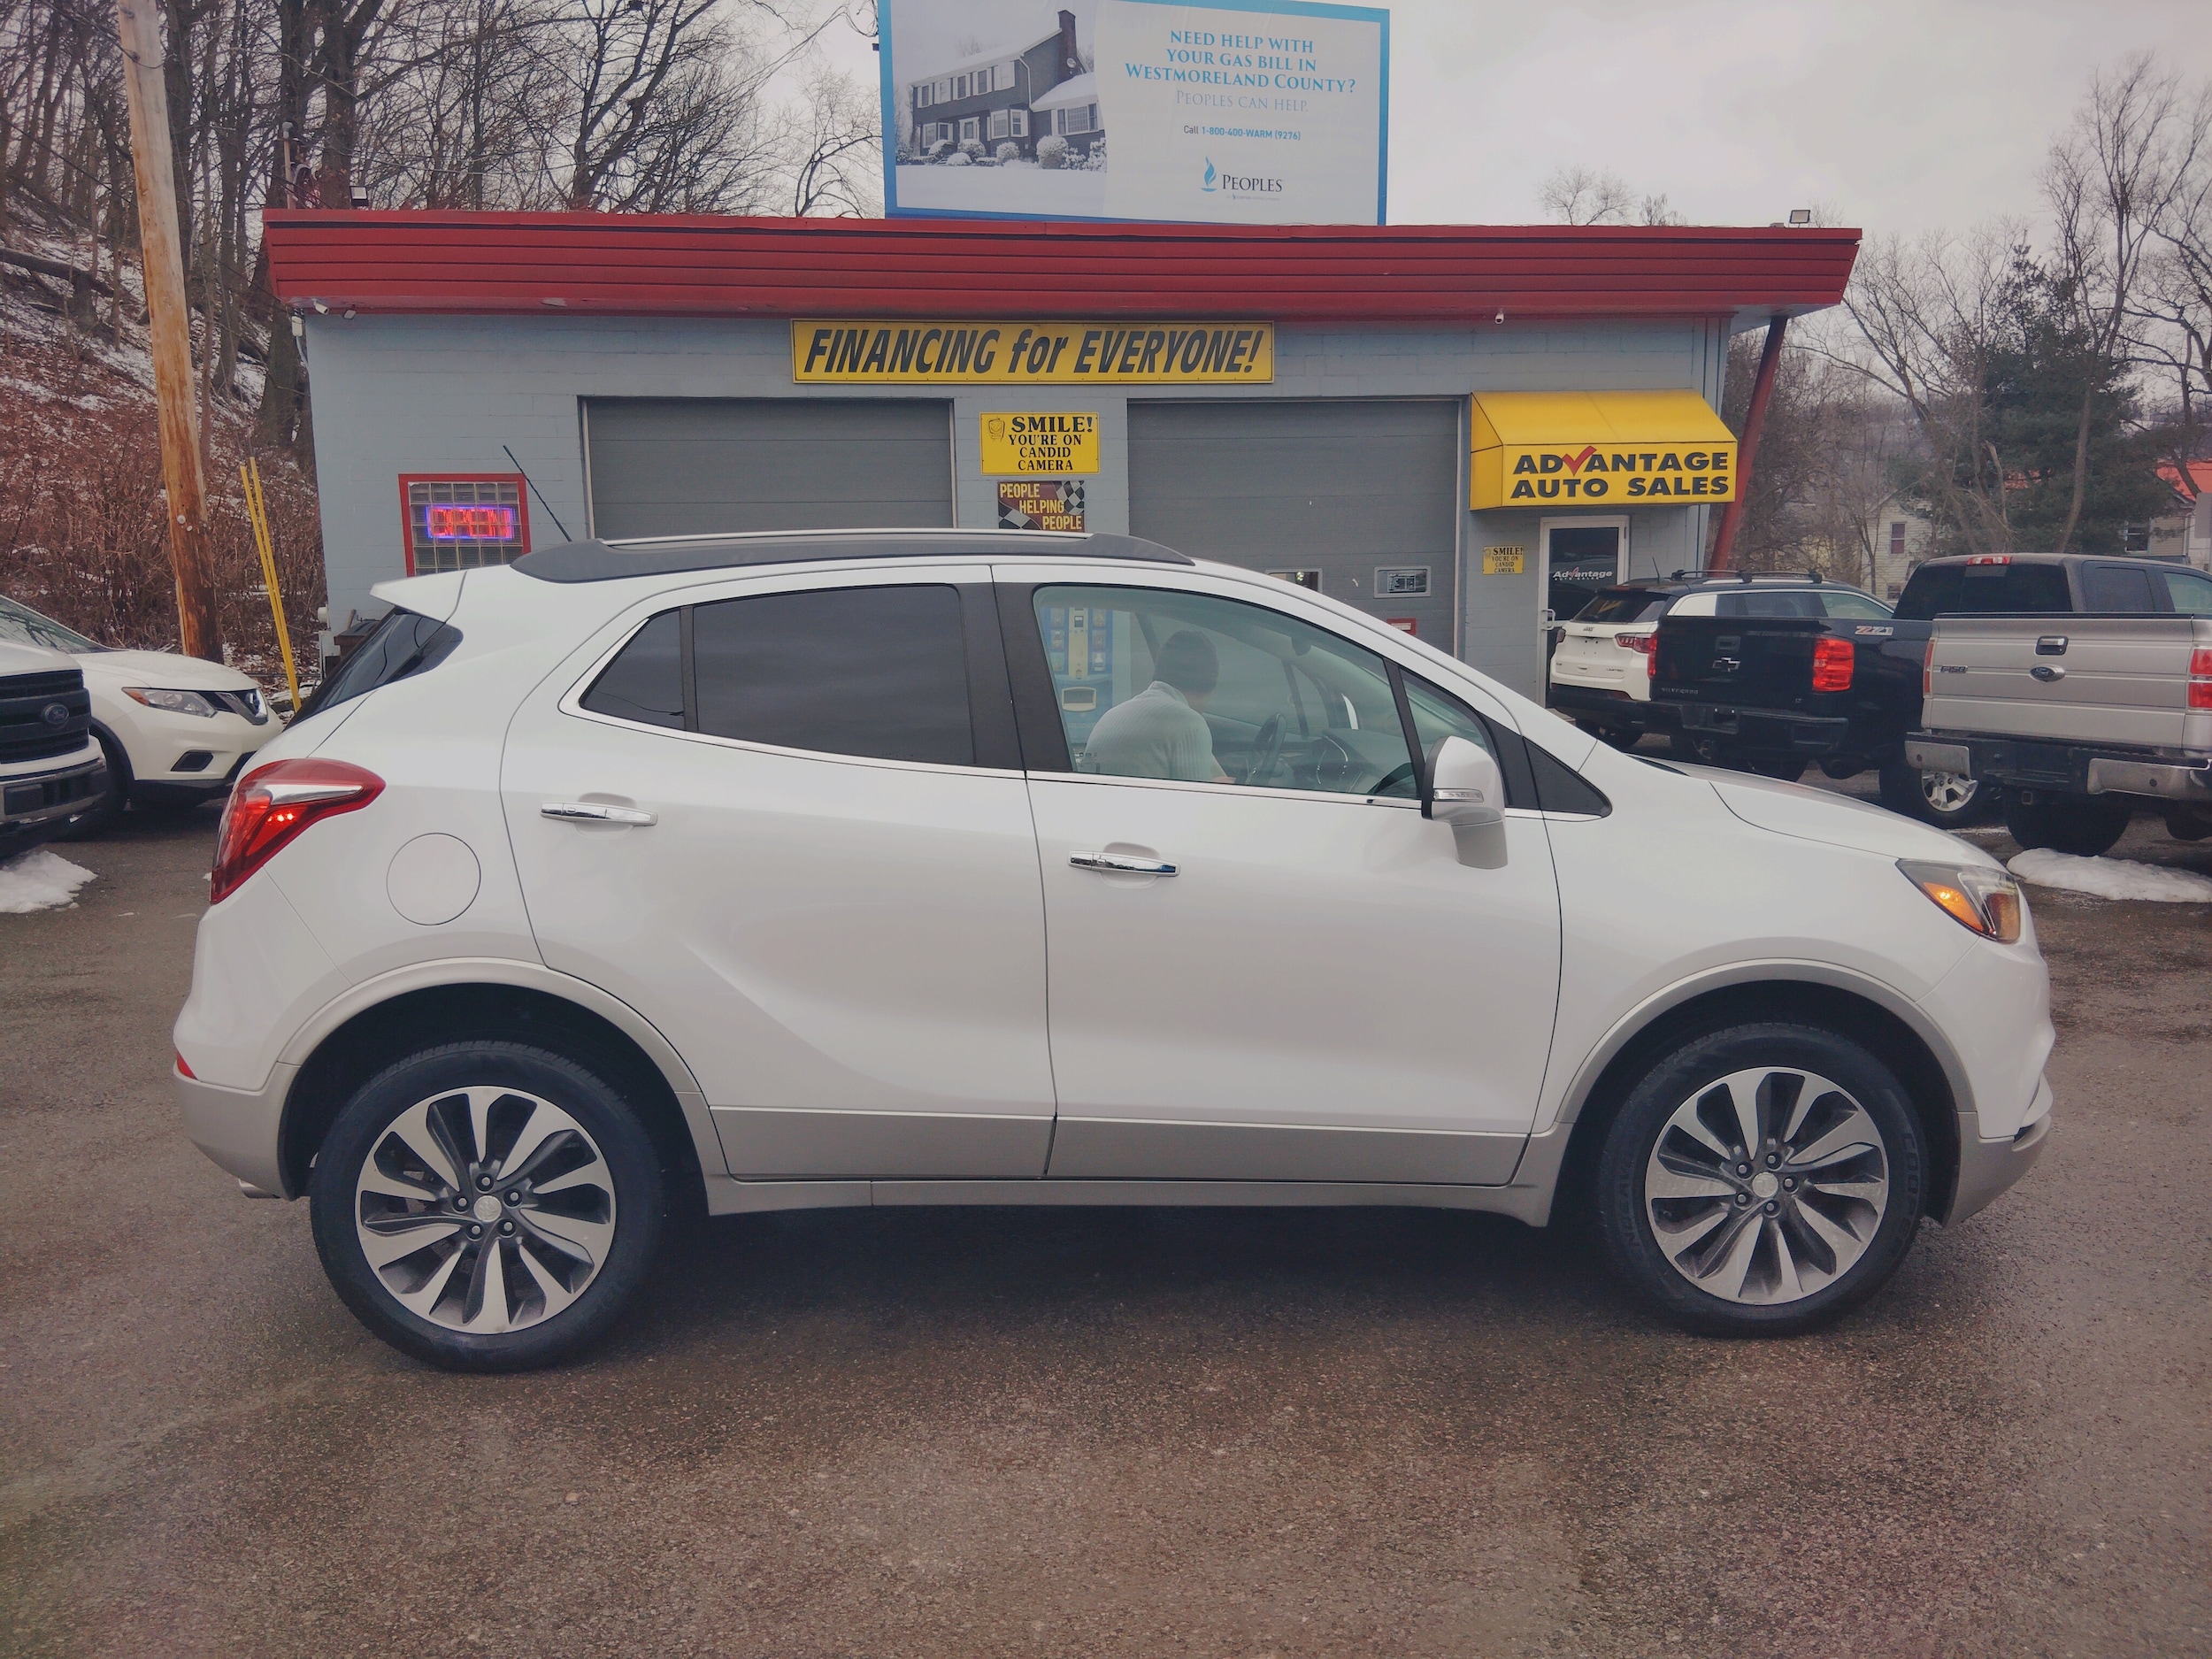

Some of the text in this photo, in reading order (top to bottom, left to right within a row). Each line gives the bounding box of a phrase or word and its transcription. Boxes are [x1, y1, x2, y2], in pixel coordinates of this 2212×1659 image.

[1170, 30, 1314, 53] NEED HELP WITH
[1166, 49, 1317, 72] YOUR GAS BILL IN
[1238, 96, 1269, 110] CAN
[1274, 98, 1309, 112] HELP.
[1183, 125, 1302, 141] Call 1-800-400-WARM (9276)
[1222, 174, 1283, 193] PEOPLES
[803, 328, 1263, 374] FINANCING for EVERYONE!
[1011, 416, 1094, 433] SMILE!
[1009, 434, 1082, 446] YOU'RE ON
[1019, 447, 1071, 458] CANDID
[1018, 459, 1073, 471] CAMERA
[1512, 446, 1728, 476] ADVANTAGE
[999, 483, 1041, 498] PEOPLE
[1510, 476, 1729, 499] AUTO SALES
[1019, 500, 1064, 514] HELPING
[1042, 515, 1082, 530] PEOPLE
[1493, 547, 1523, 556] SMILE!
